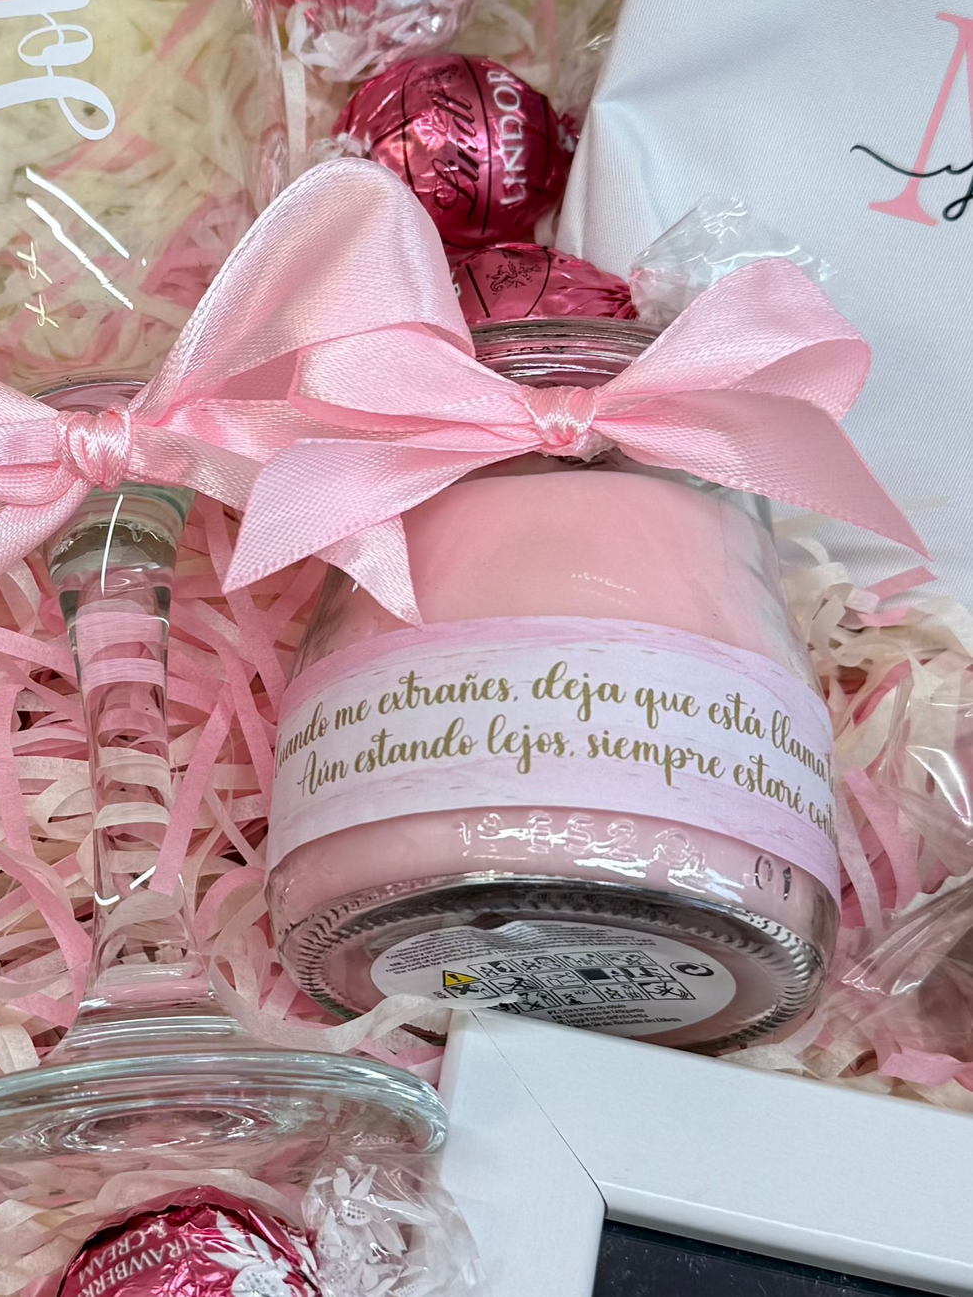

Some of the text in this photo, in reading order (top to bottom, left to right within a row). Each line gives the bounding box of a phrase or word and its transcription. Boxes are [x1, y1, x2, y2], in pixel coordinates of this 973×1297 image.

[431, 88, 479, 221] Lindt
[485, 69, 527, 206] LINDOR
[334, 697, 372, 734] me
[531, 660, 626, 722] deja
[634, 687, 701, 731] que
[708, 692, 767, 741] está
[296, 750, 350, 797] Aún
[354, 717, 478, 773] estando
[587, 729, 727, 787] siempre
[732, 753, 806, 815] estaré
[78, 1232, 146, 1285] CREAM
